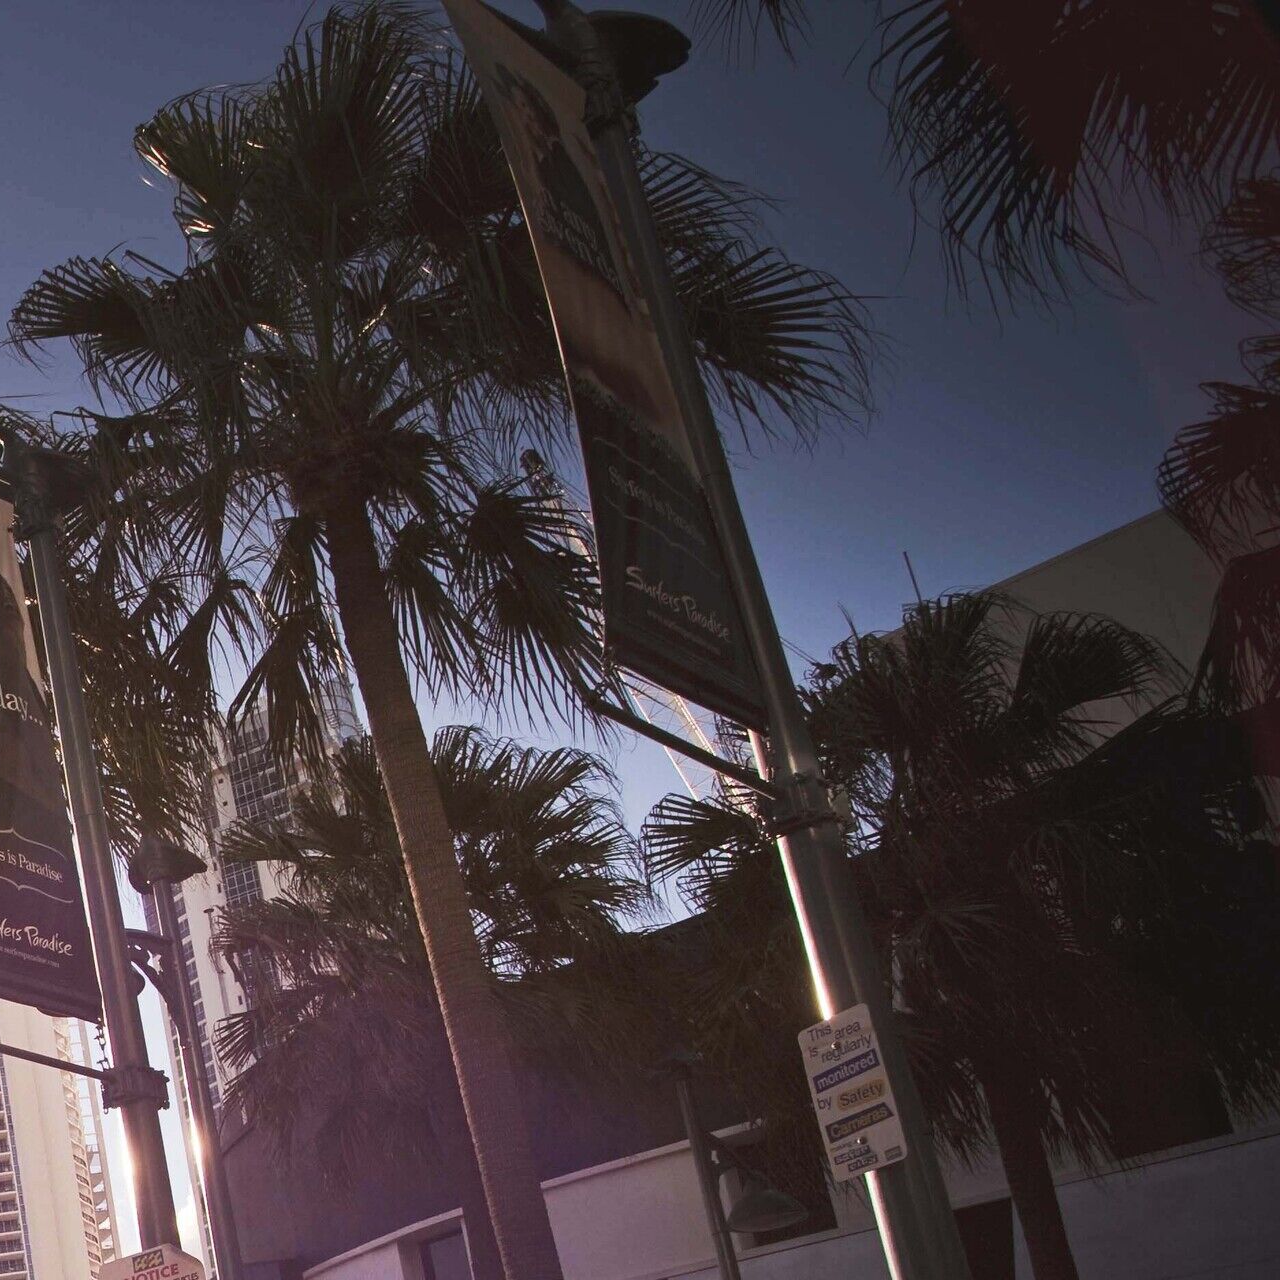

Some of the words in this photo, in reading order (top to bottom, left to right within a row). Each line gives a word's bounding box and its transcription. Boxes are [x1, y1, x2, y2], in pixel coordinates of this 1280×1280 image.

[625, 565, 681, 613] Surfers
[7, 849, 17, 866] is
[18, 853, 63, 883] Paradise
[24, 926, 74, 956] Paradise
[807, 1025, 832, 1041] This
[835, 1021, 861, 1040] area
[808, 1046, 818, 1059] is
[822, 1032, 872, 1062] regularly
[817, 1053, 876, 1089] monitored
[817, 1096, 832, 1110] by
[840, 1082, 884, 1106] Safety
[831, 1107, 888, 1136] Cameras
